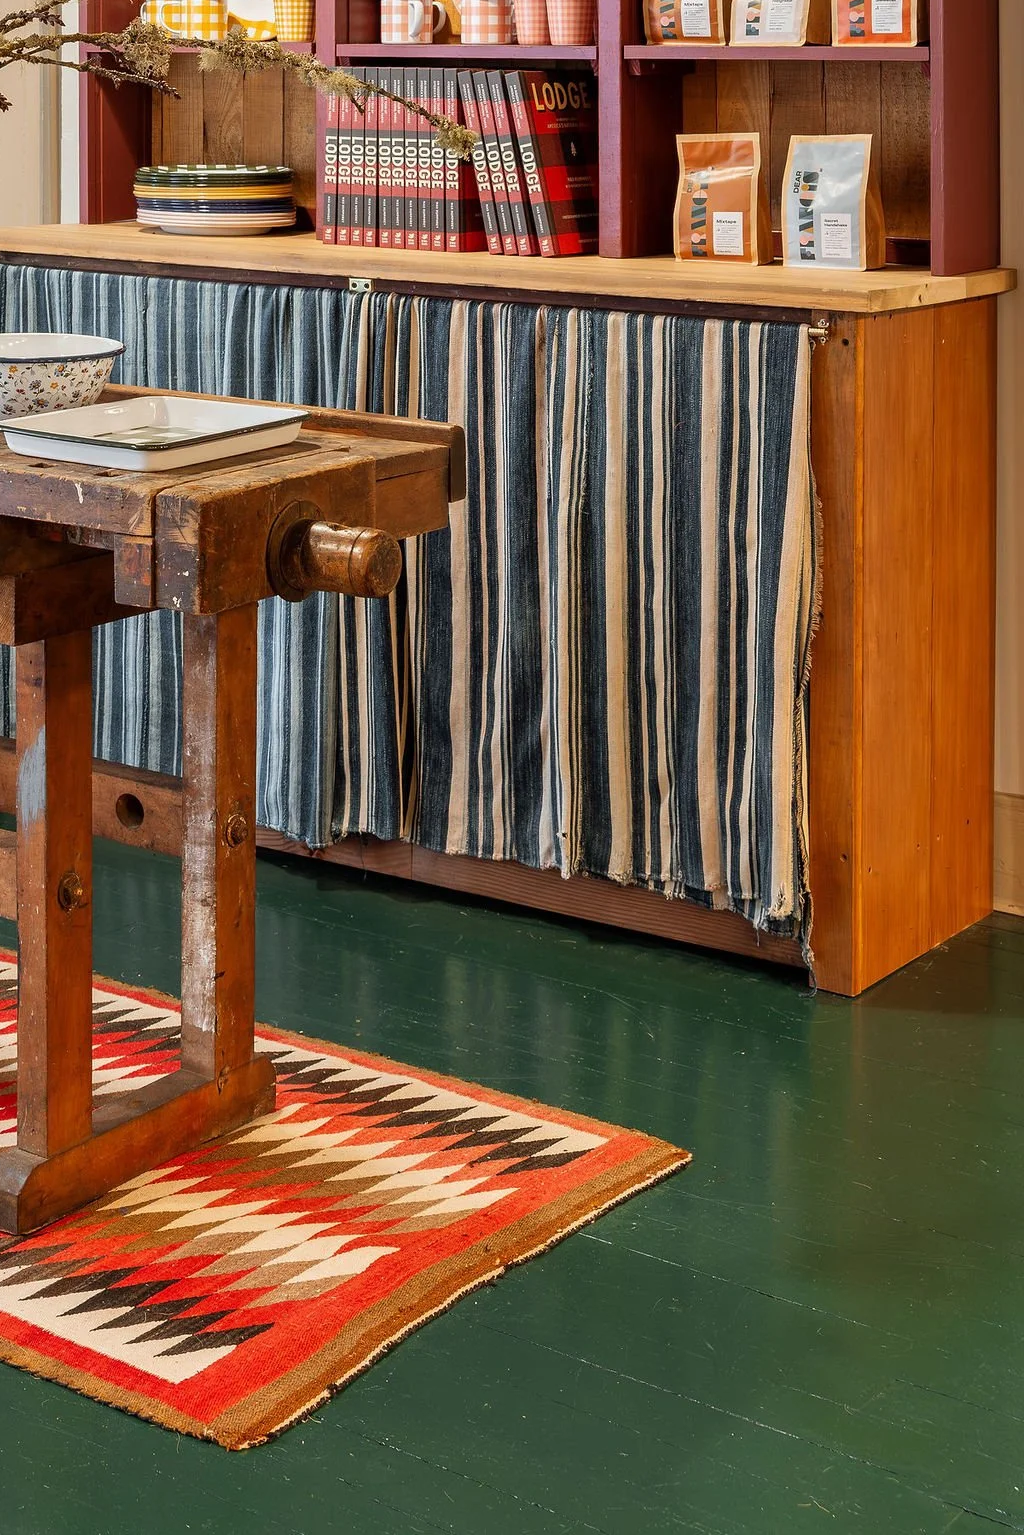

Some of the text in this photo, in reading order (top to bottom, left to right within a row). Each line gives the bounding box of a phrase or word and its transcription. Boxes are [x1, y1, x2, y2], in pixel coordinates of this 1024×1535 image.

[531, 81, 592, 111] LODGE
[325, 135, 337, 184] LODGE
[338, 136, 351, 185] LODGE
[351, 136, 364, 185] LODGE
[365, 137, 377, 186] LODGE
[378, 137, 391, 187] LODGE
[391, 138, 404, 187] LODGE
[405, 138, 417, 188] LODGE
[418, 139, 431, 189] LODGE
[431, 139, 444, 189] LODGE
[446, 148, 459, 190] ODGE
[485, 141, 505, 193] LODGE
[500, 141, 520, 193] LODGE
[519, 142, 542, 194] LODGE
[793, 170, 802, 194] DEAR
